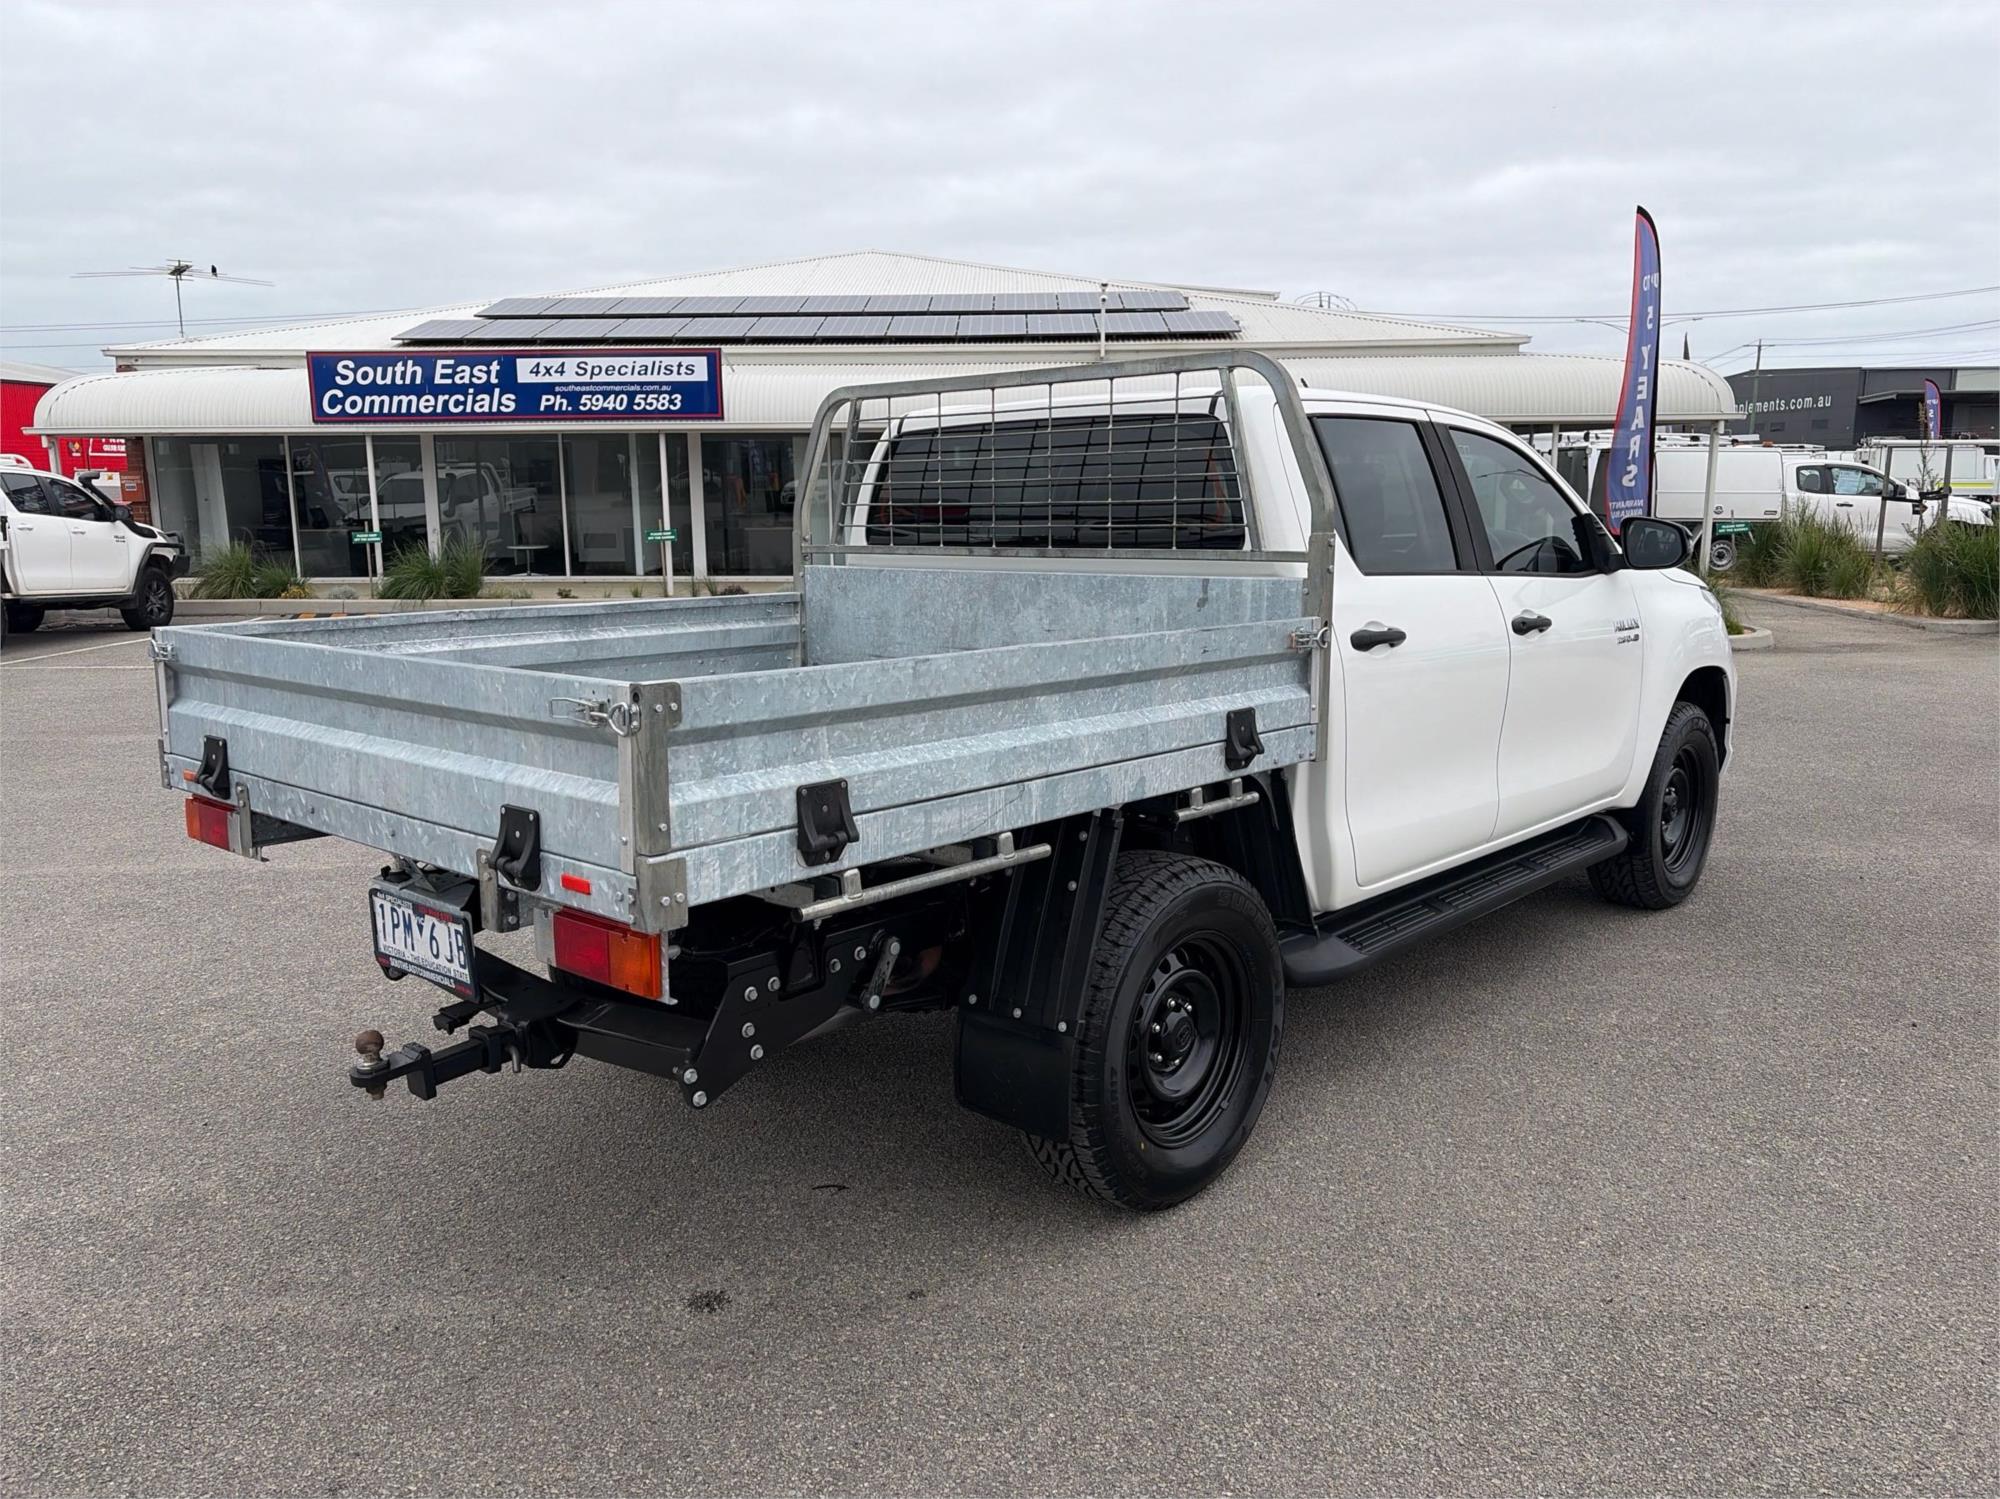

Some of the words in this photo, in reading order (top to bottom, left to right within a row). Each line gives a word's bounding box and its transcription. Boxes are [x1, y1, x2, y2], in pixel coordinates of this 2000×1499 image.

[335, 359, 422, 385] South
[434, 359, 500, 384] East
[529, 361, 566, 377] 4x4
[575, 360, 696, 380] Specialists
[554, 383, 672, 392] southeastcommercials.com.au
[322, 387, 517, 414] Commercials
[540, 394, 573, 411] Ph.
[578, 394, 628, 411] 5940
[632, 393, 682, 410] 5583
[379, 903, 415, 952] 1PM
